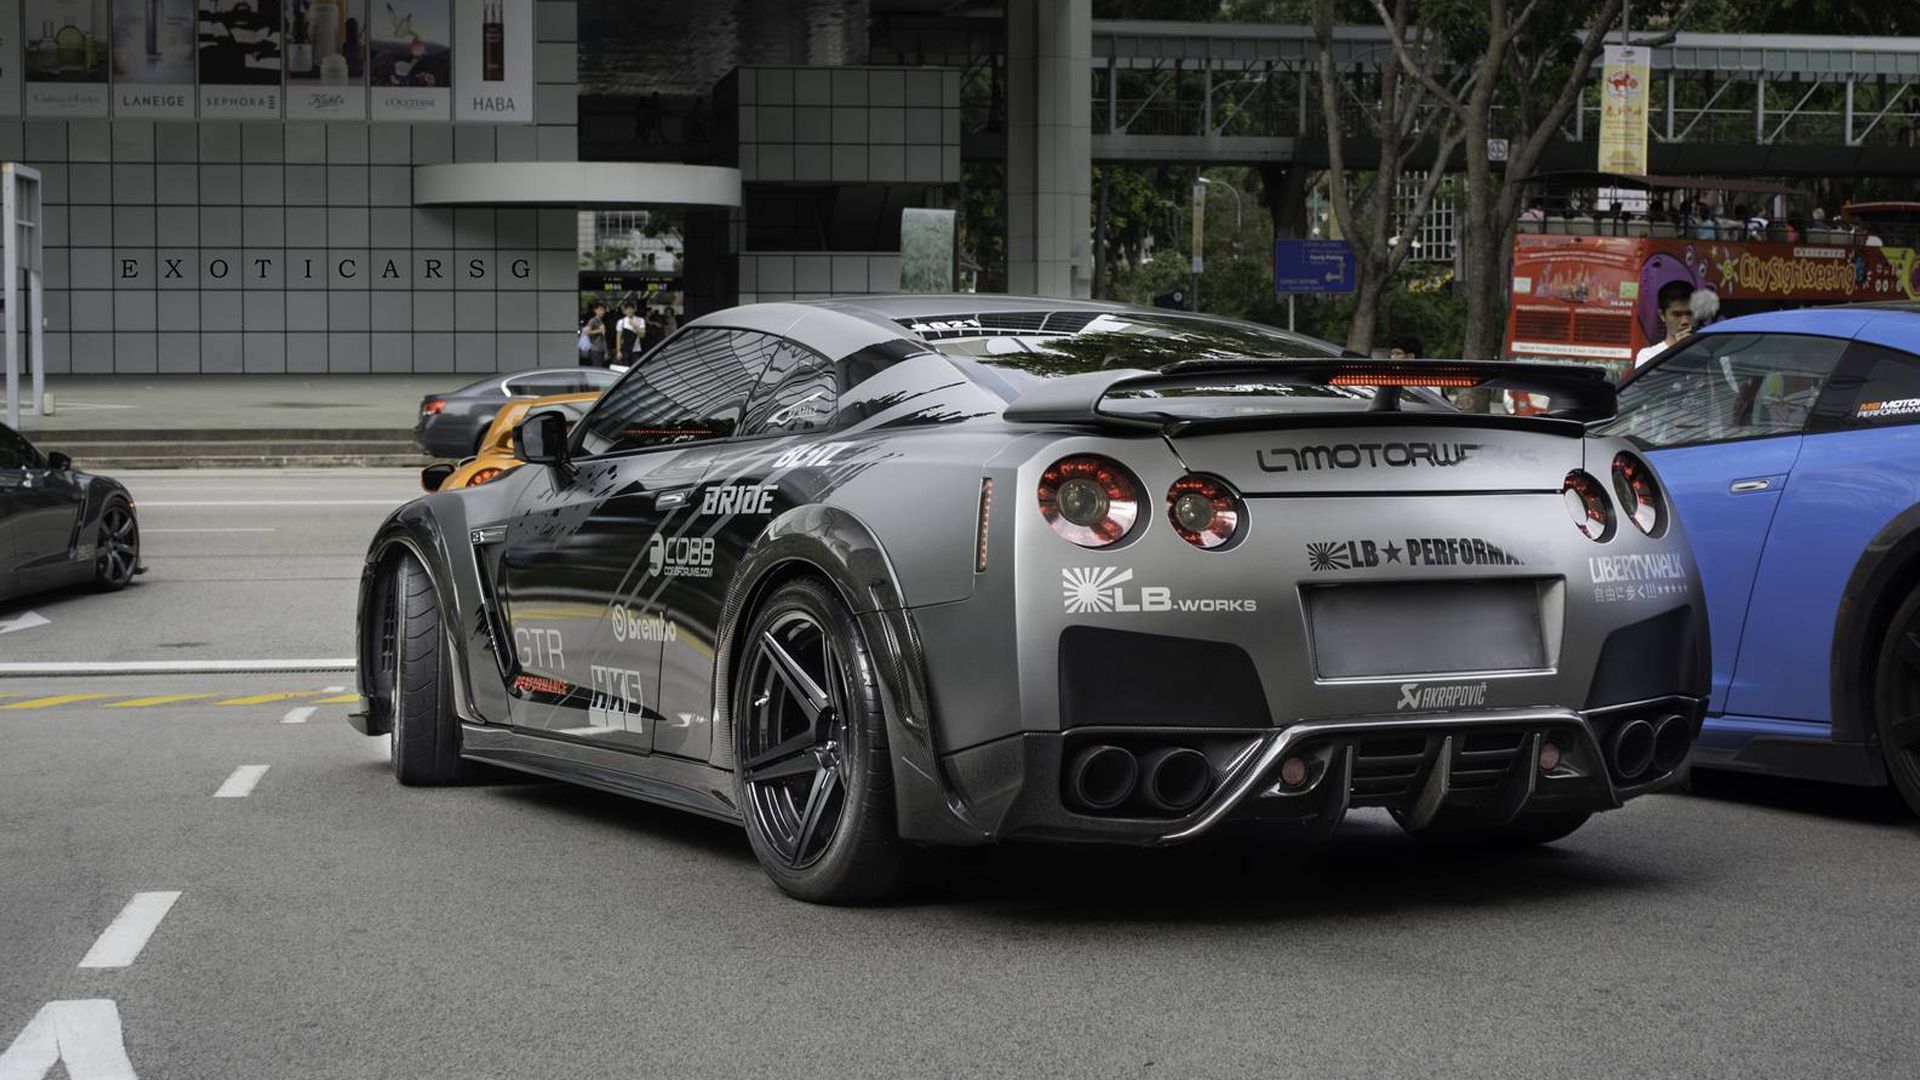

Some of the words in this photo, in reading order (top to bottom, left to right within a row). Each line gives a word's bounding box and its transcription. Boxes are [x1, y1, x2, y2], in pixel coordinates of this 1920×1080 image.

[122, 95, 185, 107] LANEIGE
[205, 96, 265, 107] SEPHORA
[473, 97, 515, 112] HABA
[701, 485, 779, 515] BRIDE
[665, 537, 715, 566] COBB
[1349, 539, 1380, 568] LB
[1406, 537, 1530, 566] PERFORMA
[627, 609, 677, 642] brembo
[514, 627, 565, 670] GTR
[513, 675, 567, 694] PERFORMANCE
